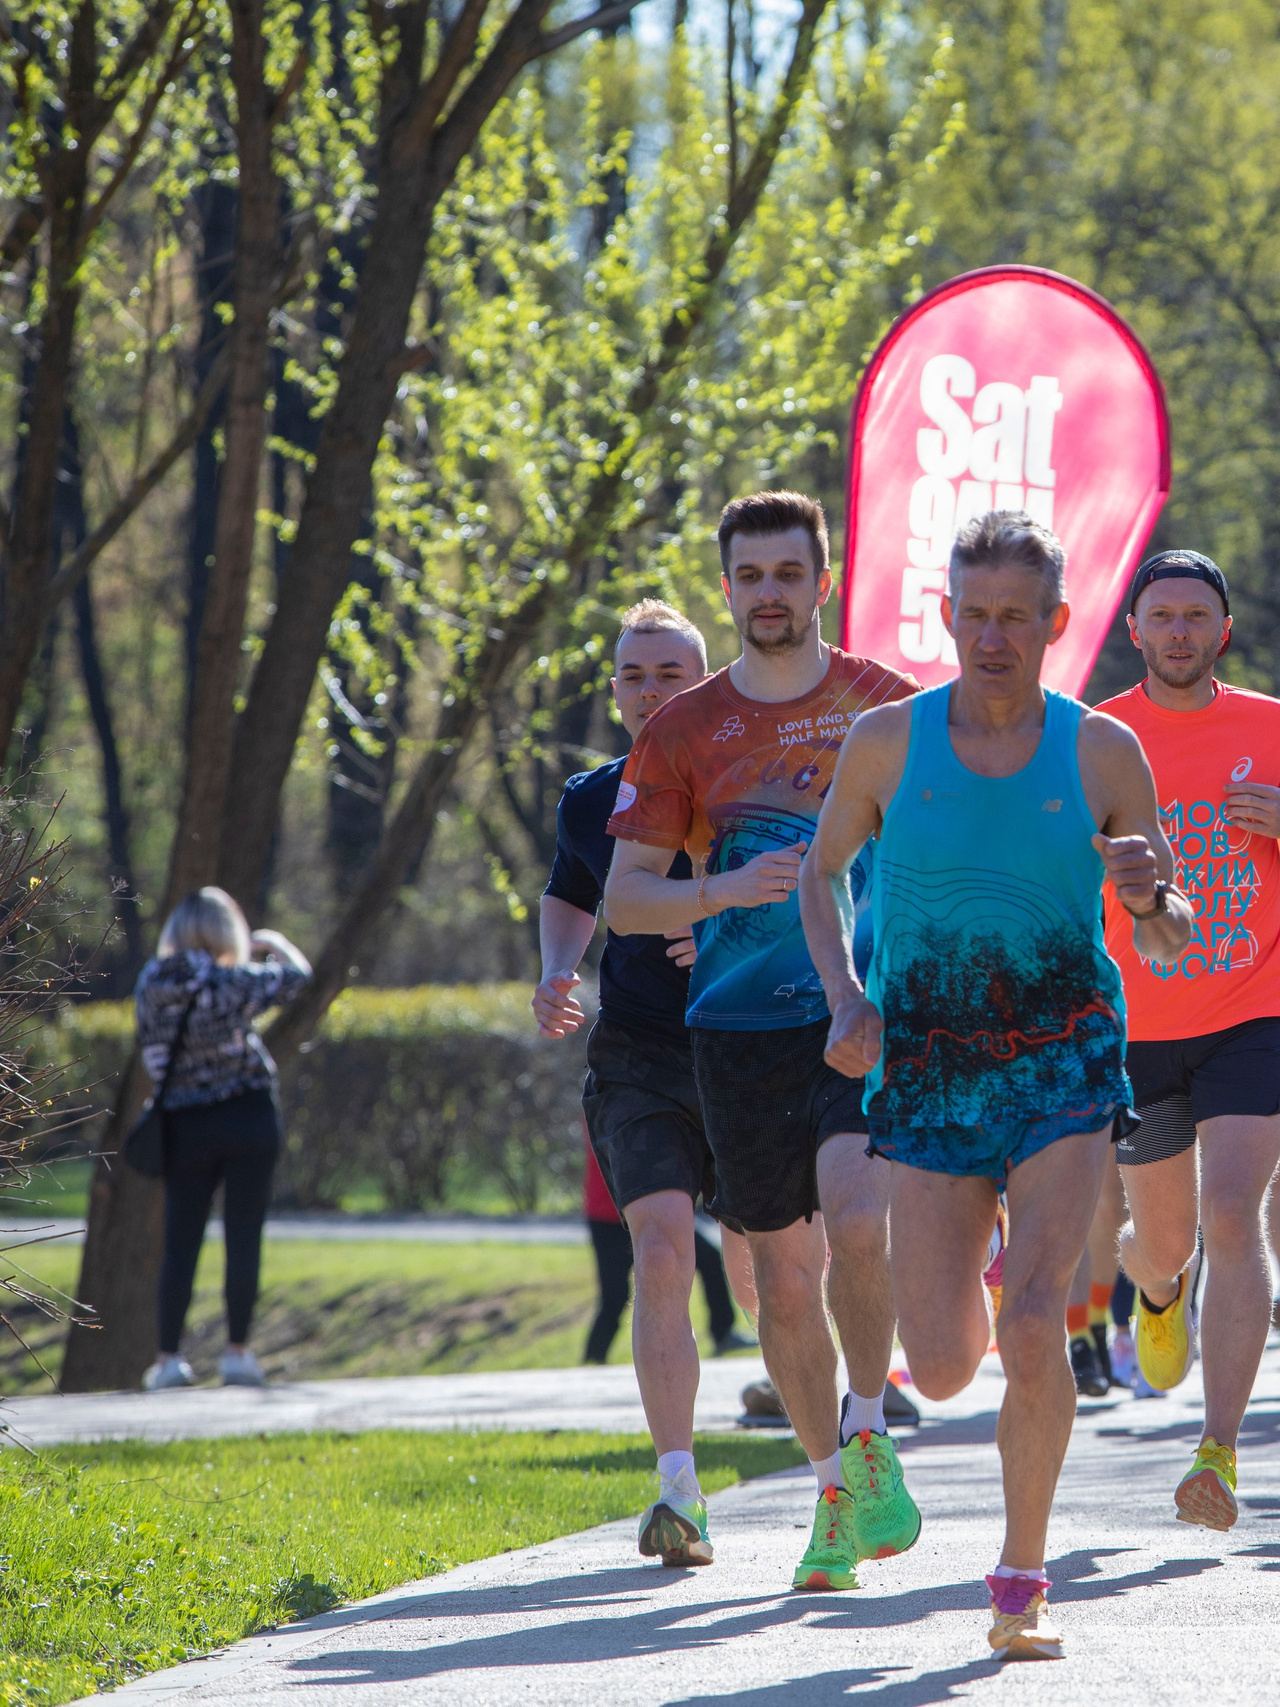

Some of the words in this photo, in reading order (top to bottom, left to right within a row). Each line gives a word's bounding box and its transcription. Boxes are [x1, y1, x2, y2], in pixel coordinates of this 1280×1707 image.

[916, 354, 1063, 487] Sat
[899, 567, 962, 666] 5
[816, 713, 844, 727] AND
[780, 730, 814, 746] HALF
[1168, 830, 1230, 860] ОВ
[1174, 851, 1255, 890] КИЙ
[1187, 889, 1254, 919] ОЛУ
[1185, 920, 1250, 950] АРА
[1151, 951, 1232, 981] ФОН
